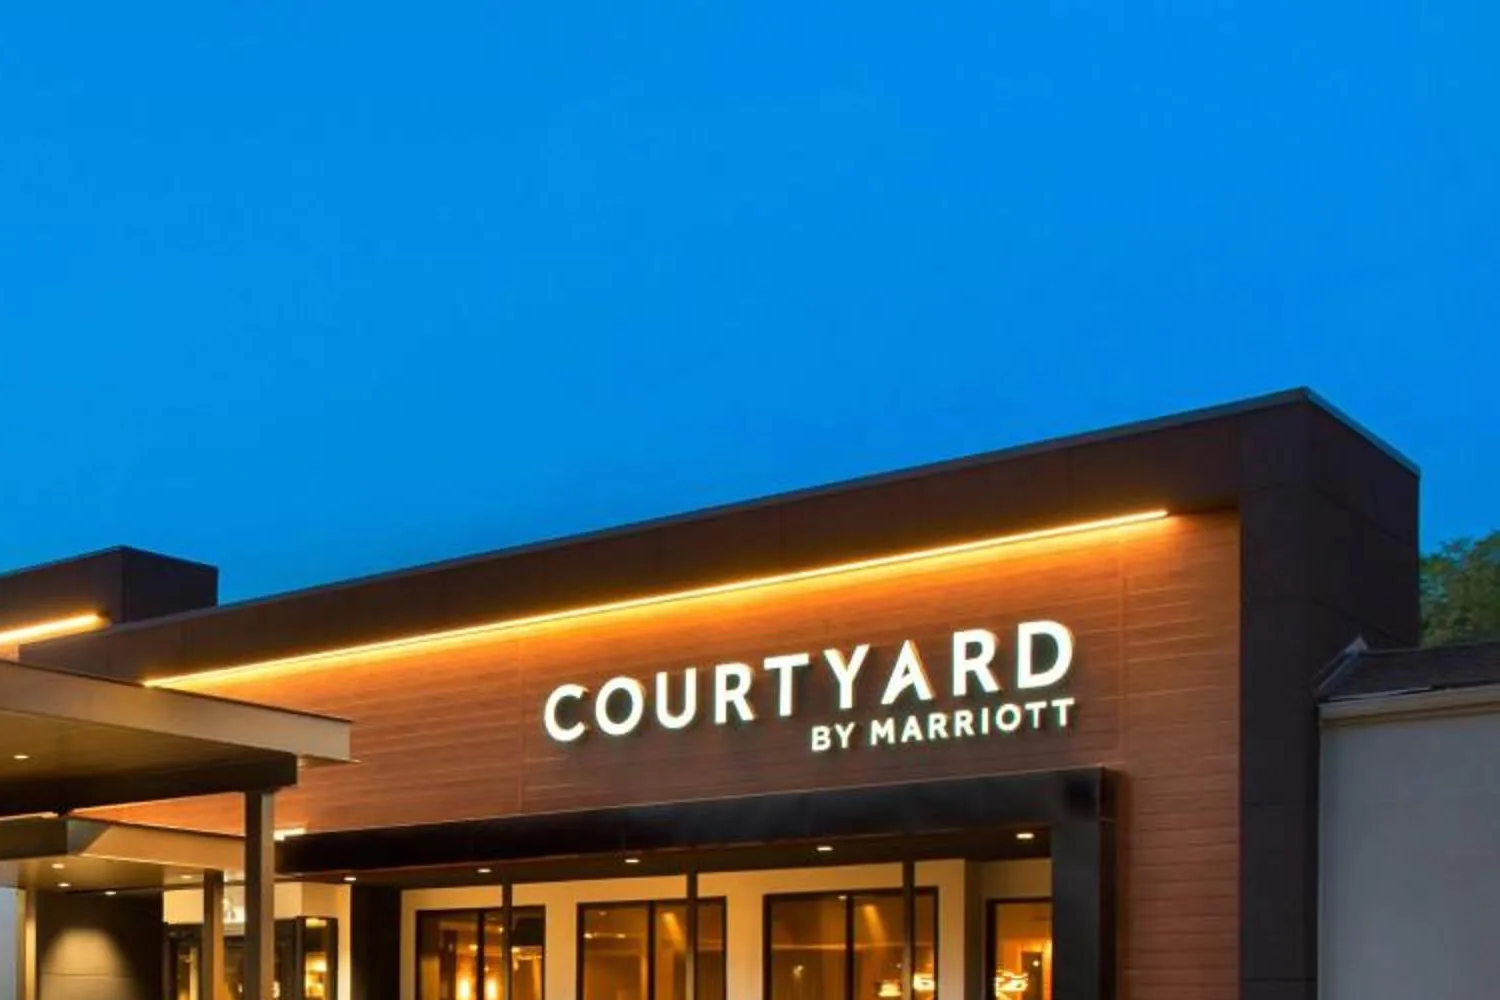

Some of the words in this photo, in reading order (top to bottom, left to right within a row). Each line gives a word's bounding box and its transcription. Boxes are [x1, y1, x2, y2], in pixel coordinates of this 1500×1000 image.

[542, 619, 1075, 743] COURTYARD
[810, 721, 856, 753] BY
[869, 696, 1076, 747] MARRIOTT
